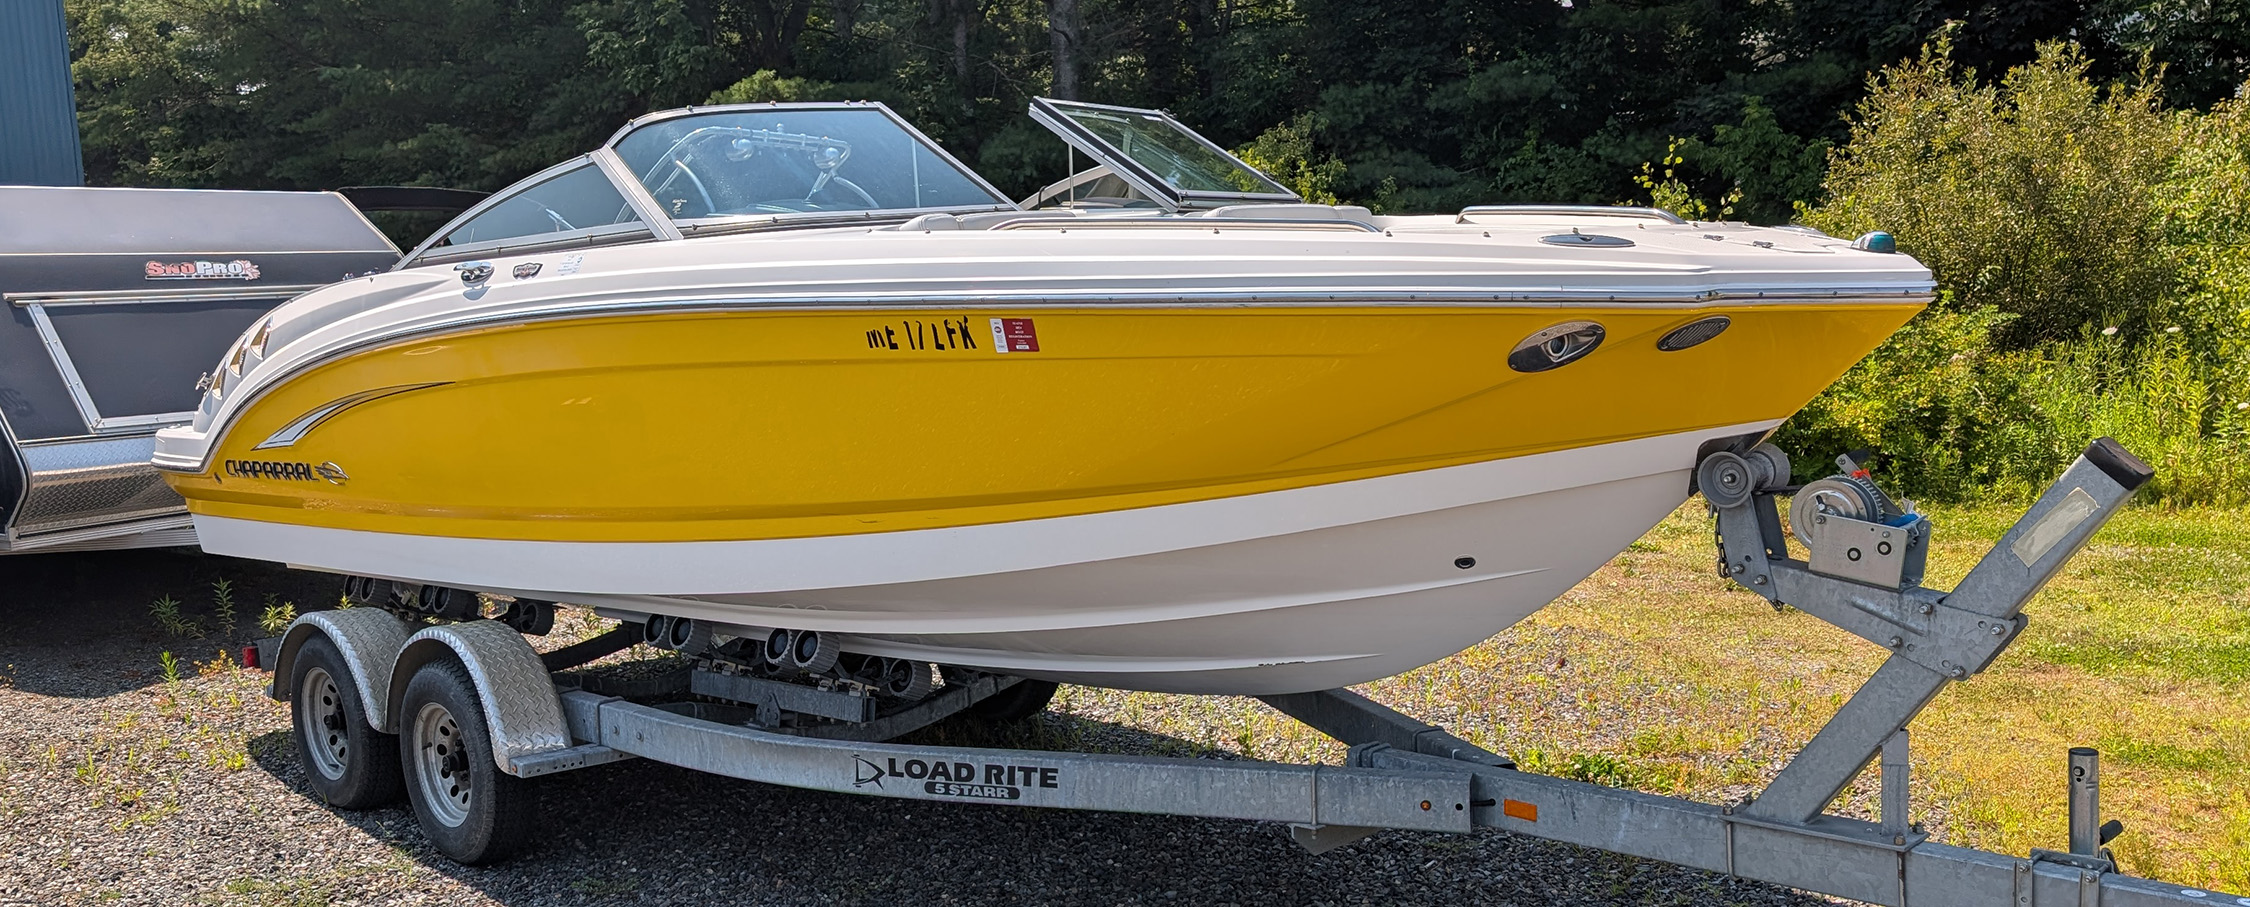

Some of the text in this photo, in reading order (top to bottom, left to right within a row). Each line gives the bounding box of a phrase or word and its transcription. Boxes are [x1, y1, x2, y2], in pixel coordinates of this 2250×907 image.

[866, 325, 899, 350] ME
[225, 459, 319, 481] CHAPARRAL
[888, 757, 1059, 789] LOAD RITE
[934, 782, 1010, 799] 5 STARR
